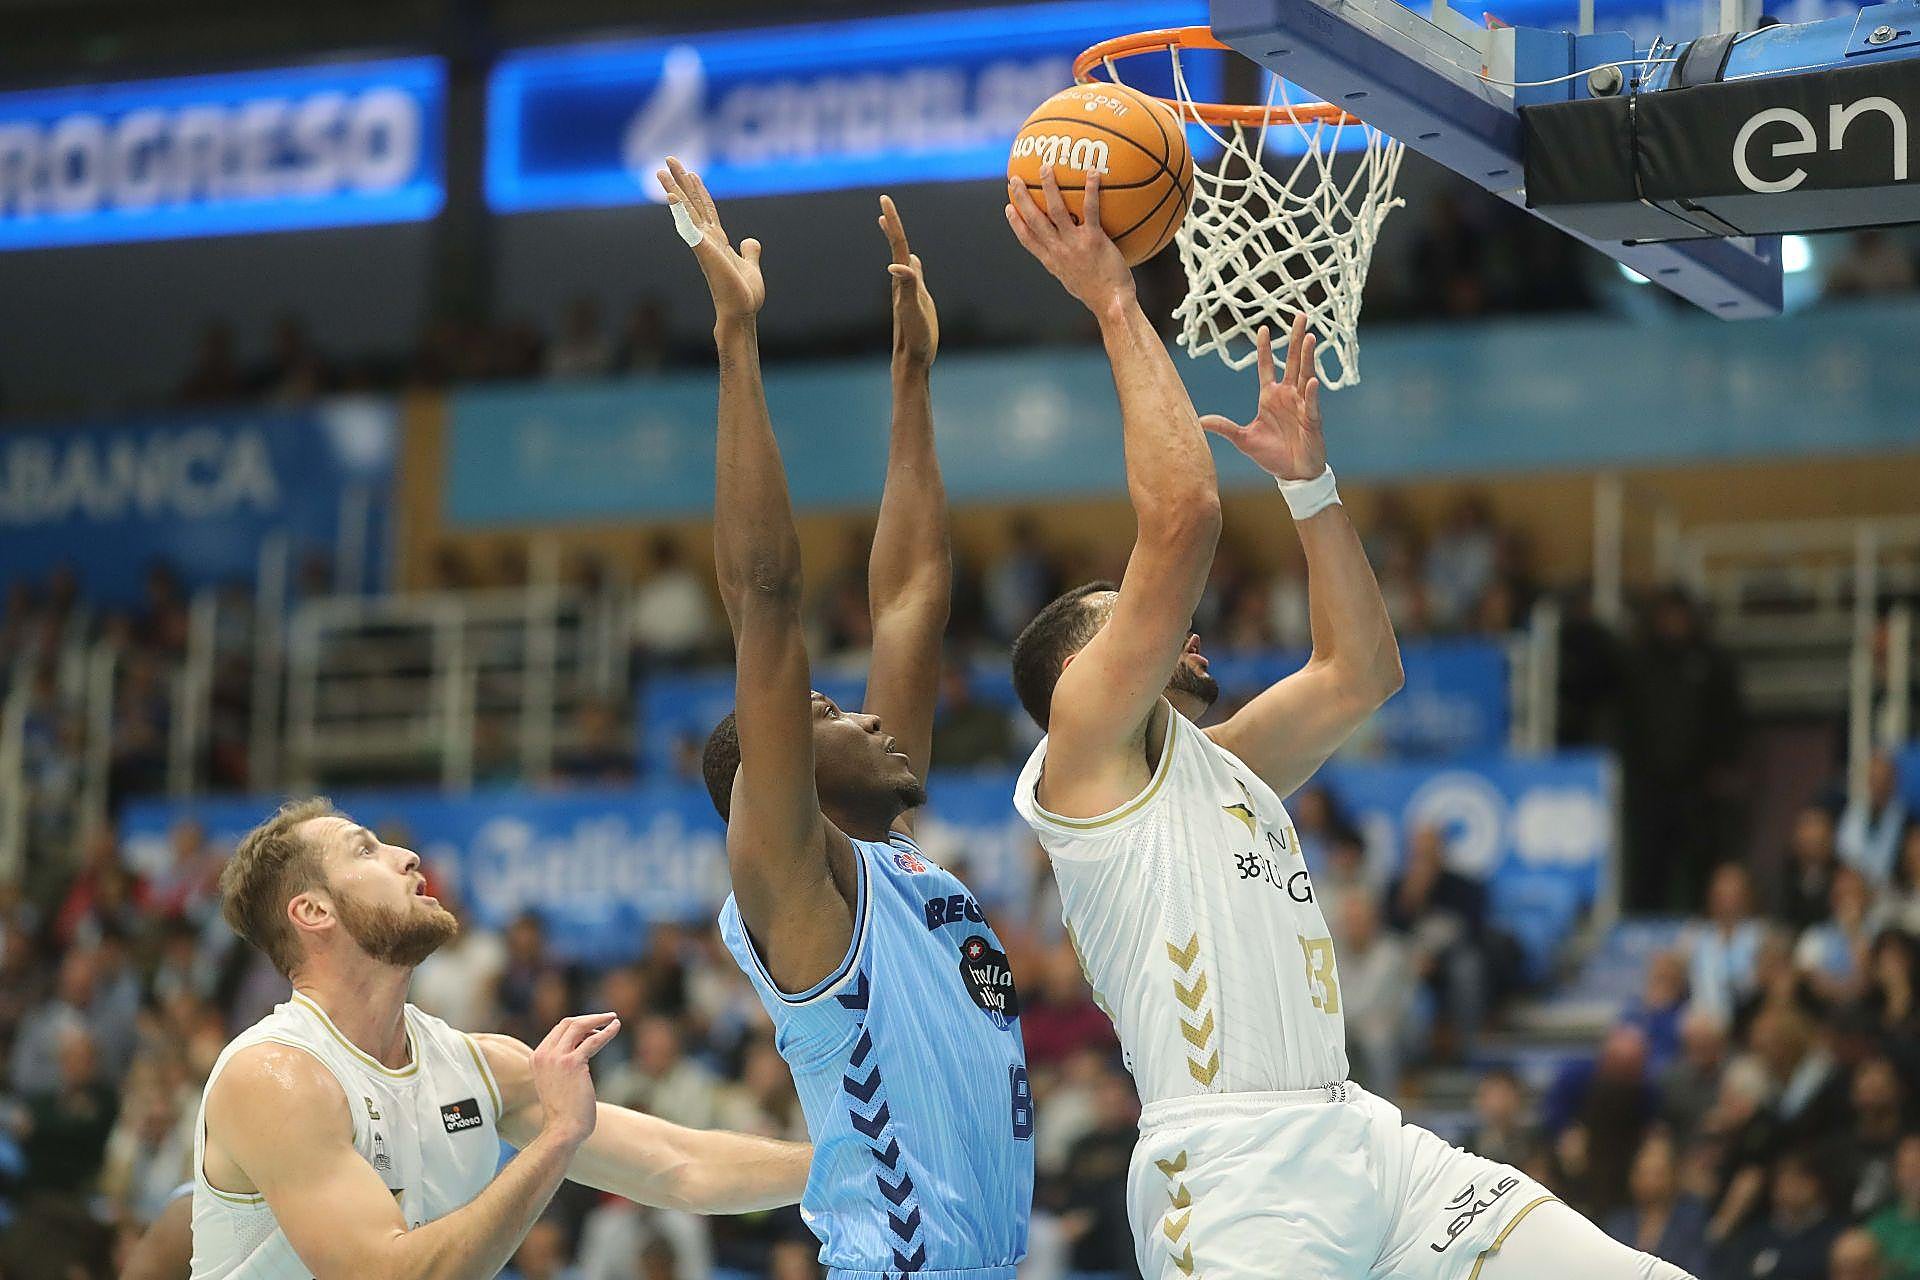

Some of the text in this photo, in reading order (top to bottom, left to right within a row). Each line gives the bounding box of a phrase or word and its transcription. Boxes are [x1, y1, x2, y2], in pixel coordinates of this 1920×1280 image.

[1012, 133, 1109, 175] Wilson
[1733, 96, 1908, 193] en
[0, 430, 278, 518] BANCA
[1430, 1176, 1520, 1253] LEXUS
